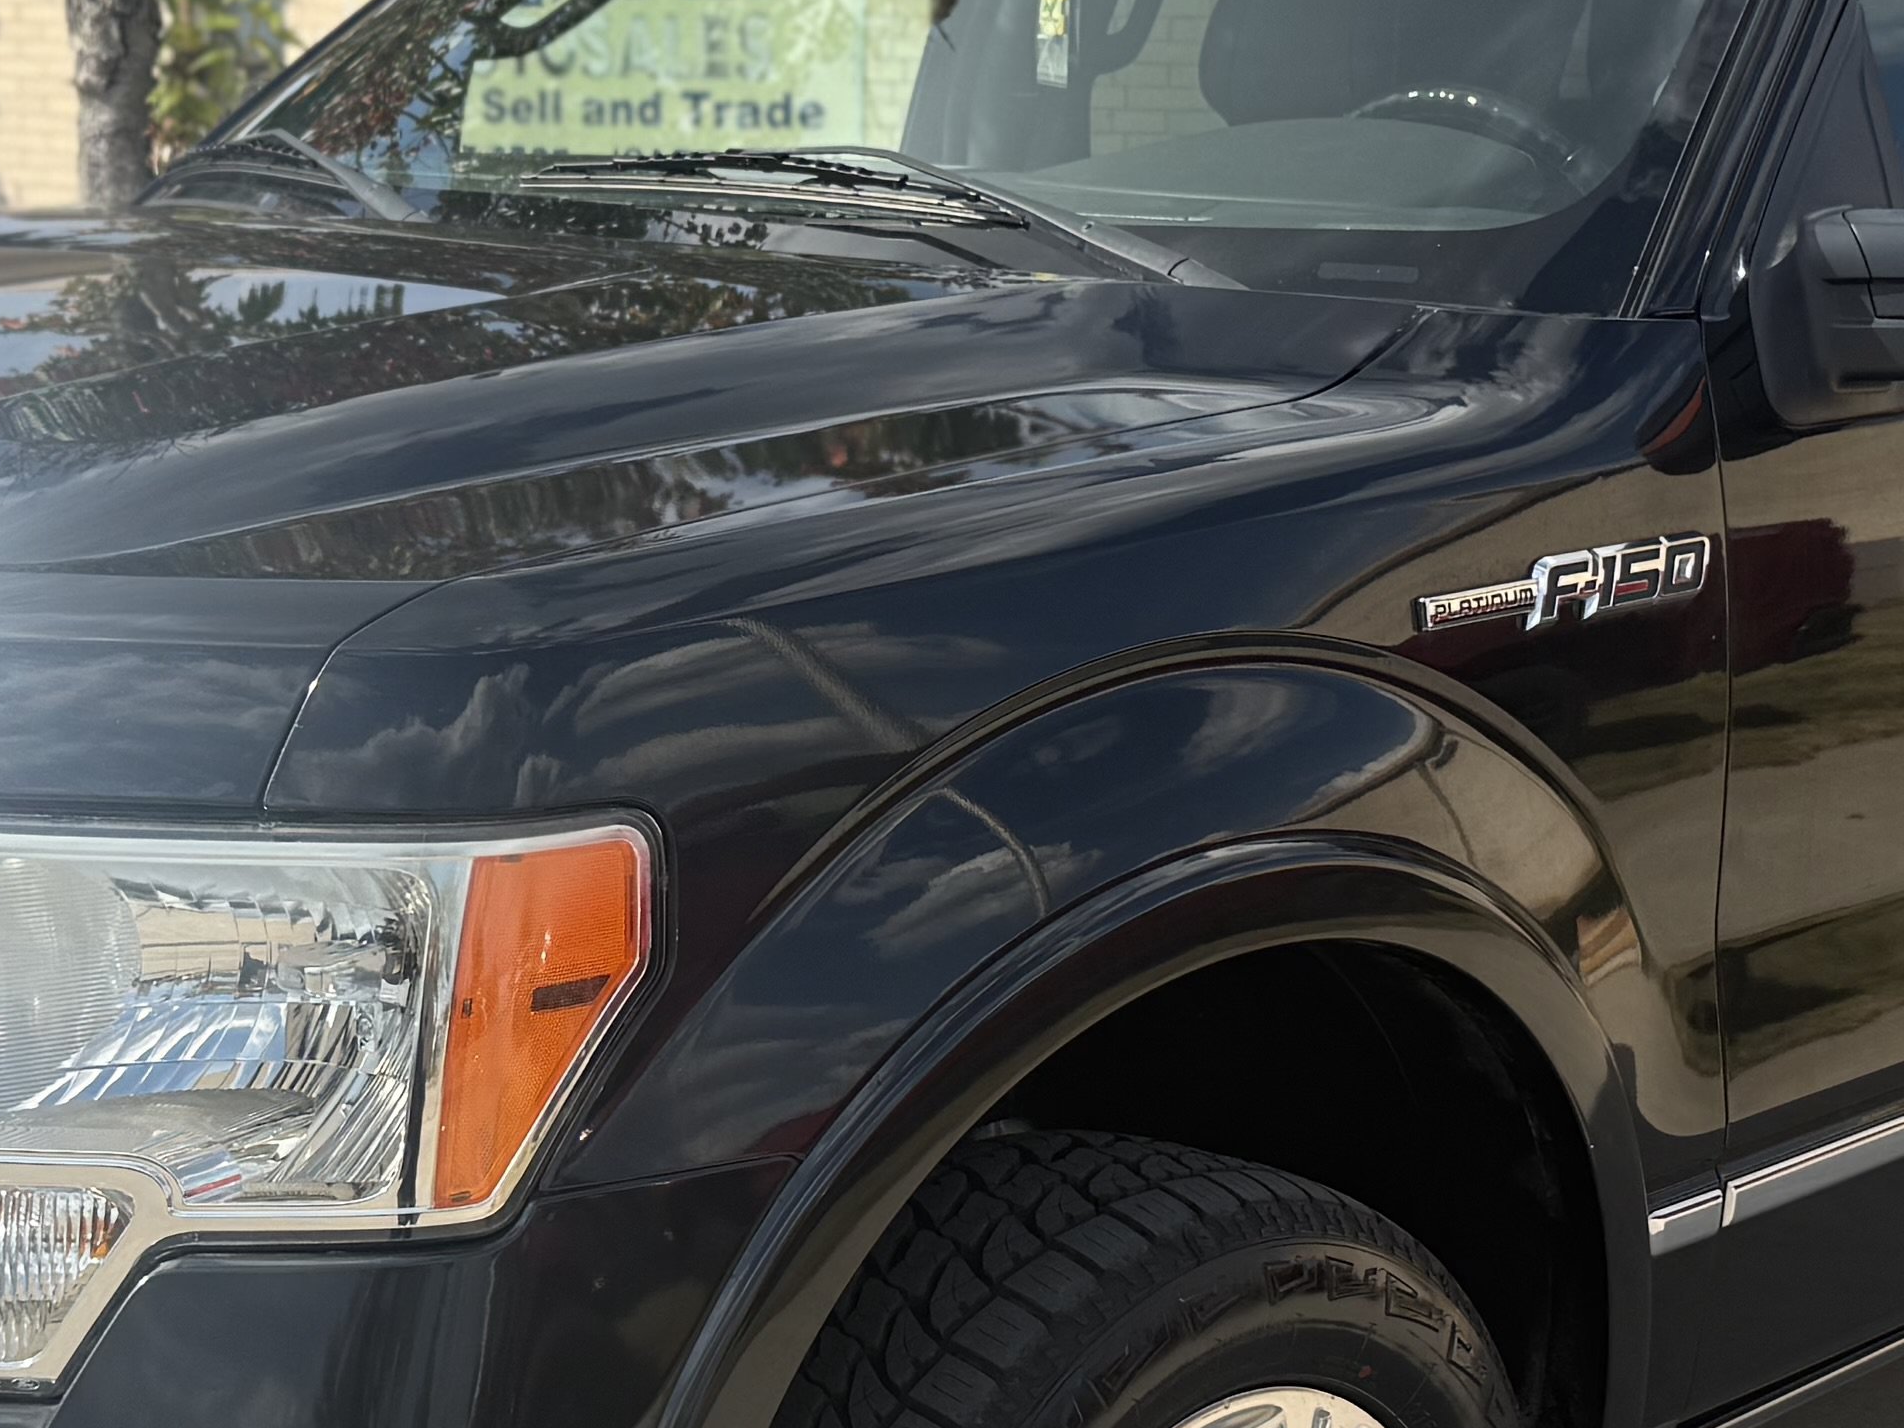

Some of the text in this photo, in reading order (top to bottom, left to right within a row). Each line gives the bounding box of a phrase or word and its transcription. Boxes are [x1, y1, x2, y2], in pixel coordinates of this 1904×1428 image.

[481, 89, 827, 131] Sell and Trade
[1432, 535, 1711, 626] PLATINUM F-150
